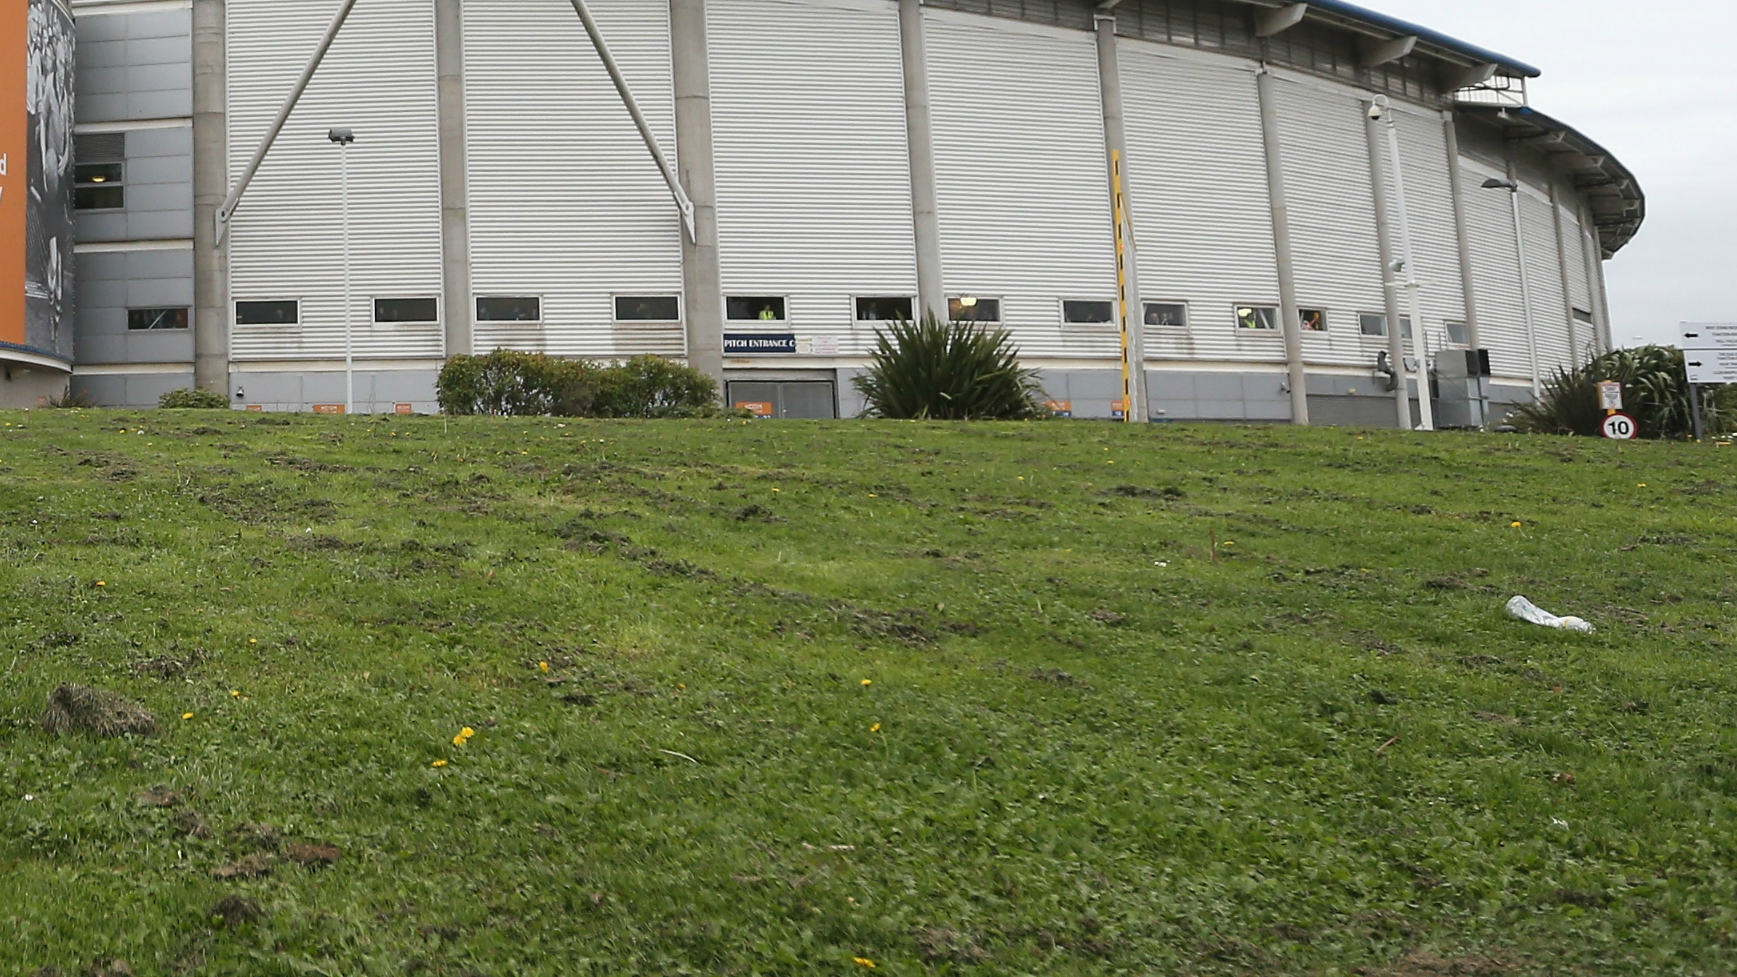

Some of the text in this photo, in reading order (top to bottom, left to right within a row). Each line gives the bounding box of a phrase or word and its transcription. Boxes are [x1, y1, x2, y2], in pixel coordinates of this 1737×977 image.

[724, 339, 747, 348] PITCH
[749, 339, 788, 348] ENTRANCE
[1607, 420, 1629, 435] 10
